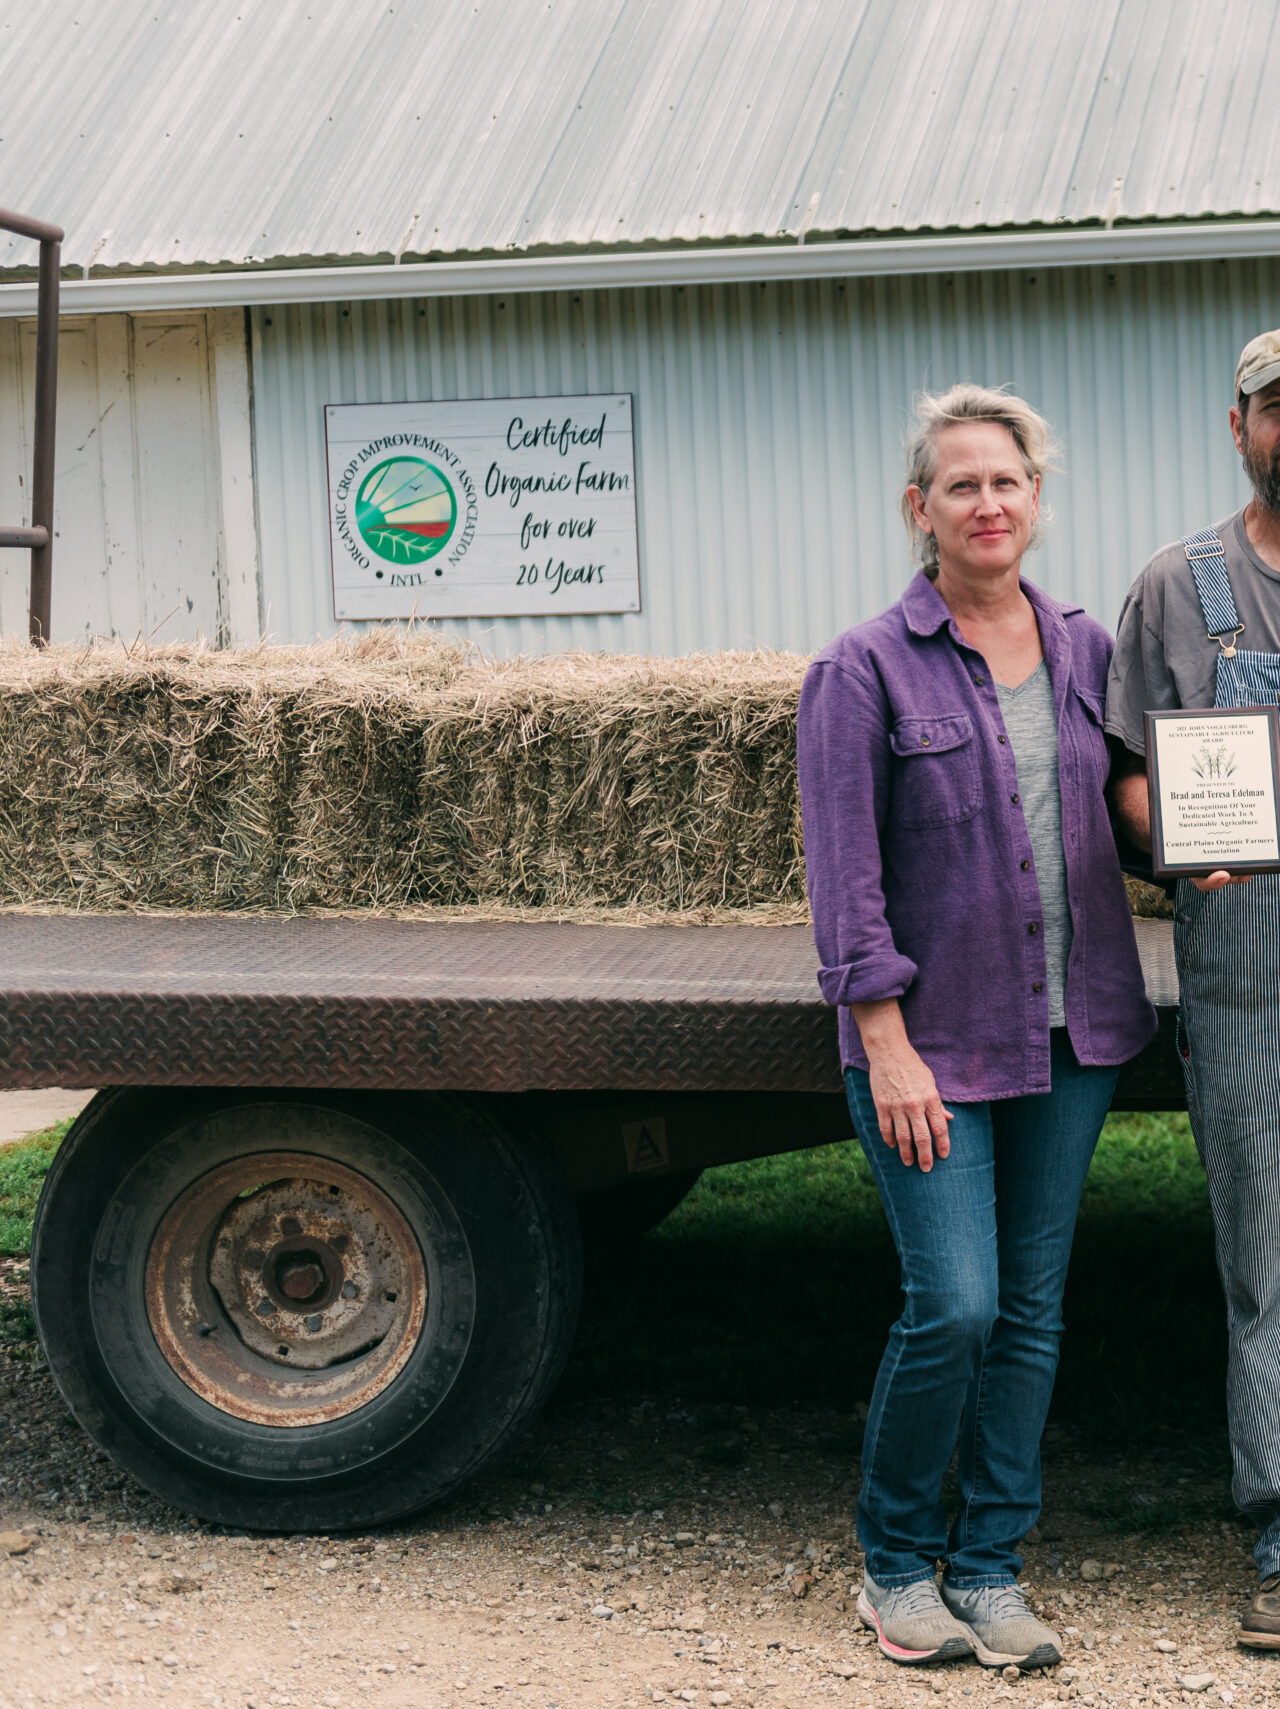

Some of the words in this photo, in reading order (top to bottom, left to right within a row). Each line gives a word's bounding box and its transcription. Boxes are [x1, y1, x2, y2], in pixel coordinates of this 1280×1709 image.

[357, 433, 462, 468] IMPROVEMENT
[507, 412, 607, 456] Certified
[336, 459, 358, 501] CROP
[485, 461, 572, 508] Organic
[575, 461, 630, 495] Farm
[335, 503, 370, 570] ORGANIC
[448, 468, 479, 567] ASSOCIATION
[520, 512, 552, 550] for
[557, 517, 598, 539] over
[390, 573, 428, 587] INTL
[516, 563, 539, 586] 20
[545, 557, 606, 594] Years
[1170, 791, 1189, 800] Brad
[1190, 791, 1205, 799] and
[1206, 790, 1231, 799] Teresa
[1232, 788, 1265, 798] Edelman
[1182, 812, 1216, 820] Dedicated
